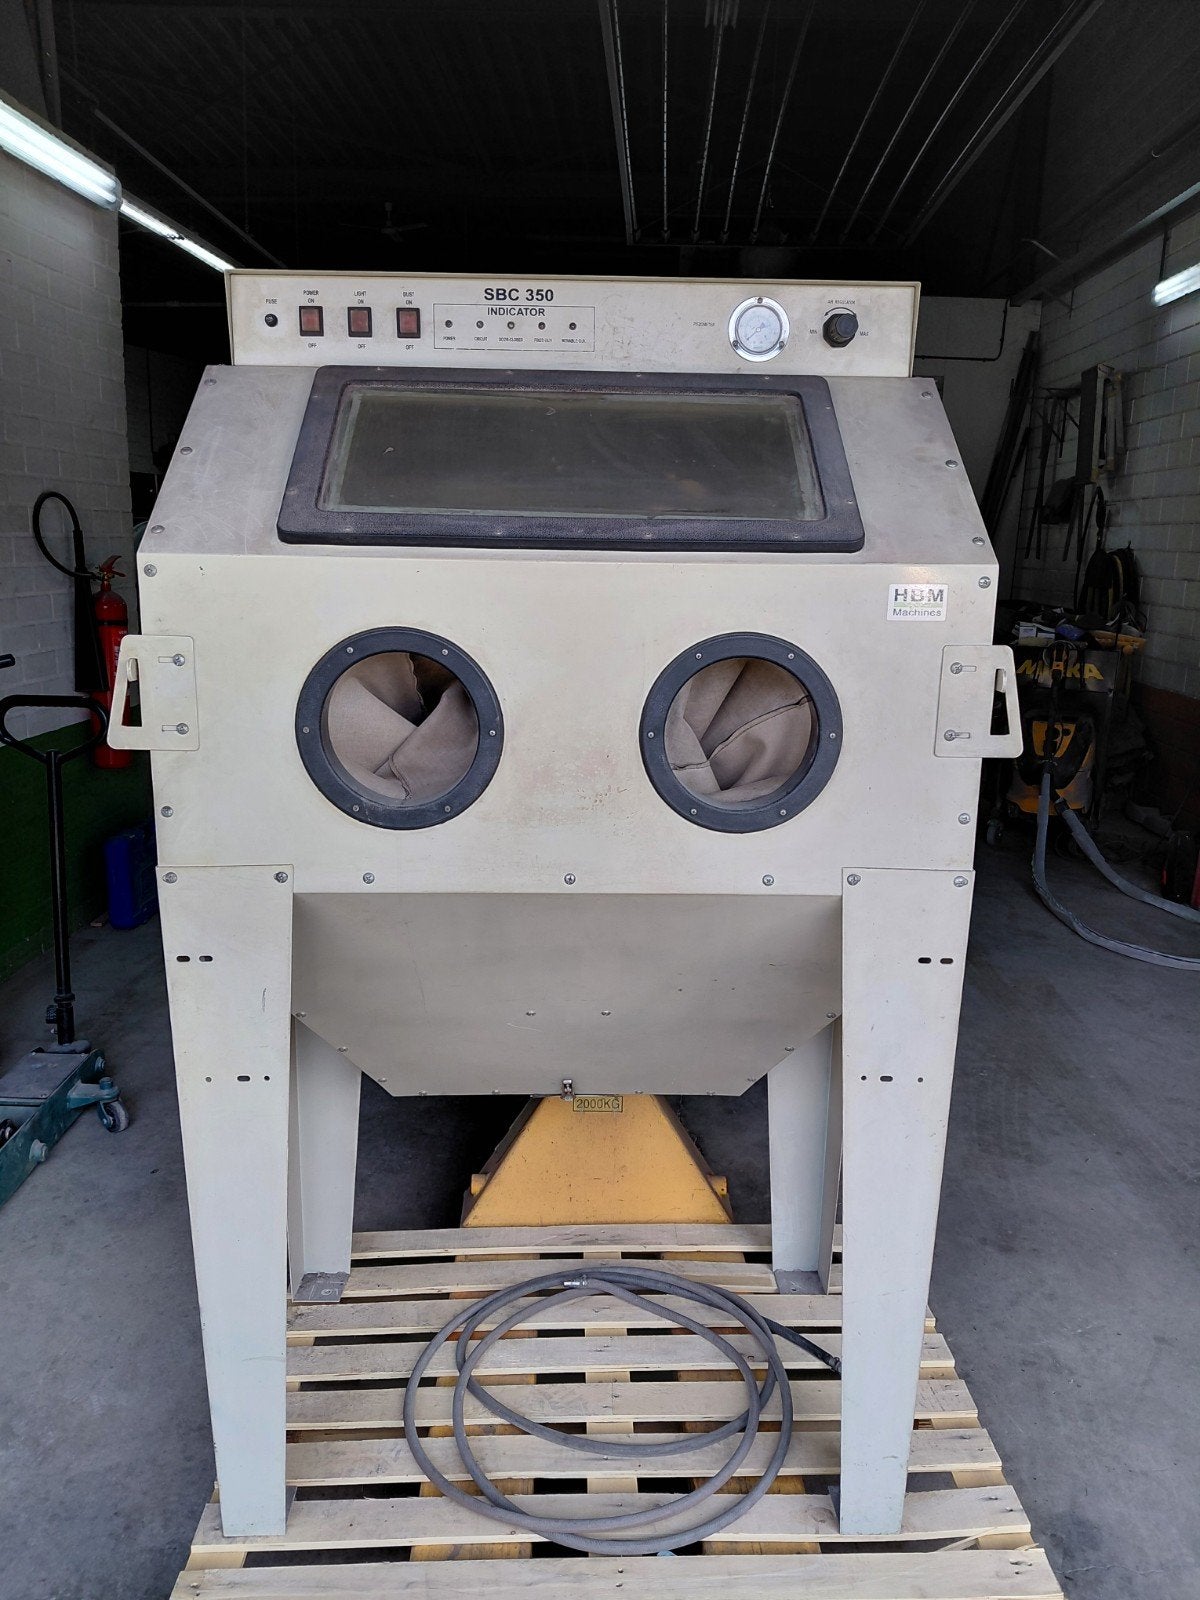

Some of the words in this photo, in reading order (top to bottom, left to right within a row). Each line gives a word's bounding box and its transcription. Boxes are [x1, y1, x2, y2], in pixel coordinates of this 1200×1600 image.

[484, 288, 519, 301] SBC
[525, 289, 554, 302] 350
[487, 307, 546, 316] INDICATOR
[894, 588, 944, 602] HBM
[892, 608, 942, 617] Machines
[576, 1098, 620, 1110] 2000KG
